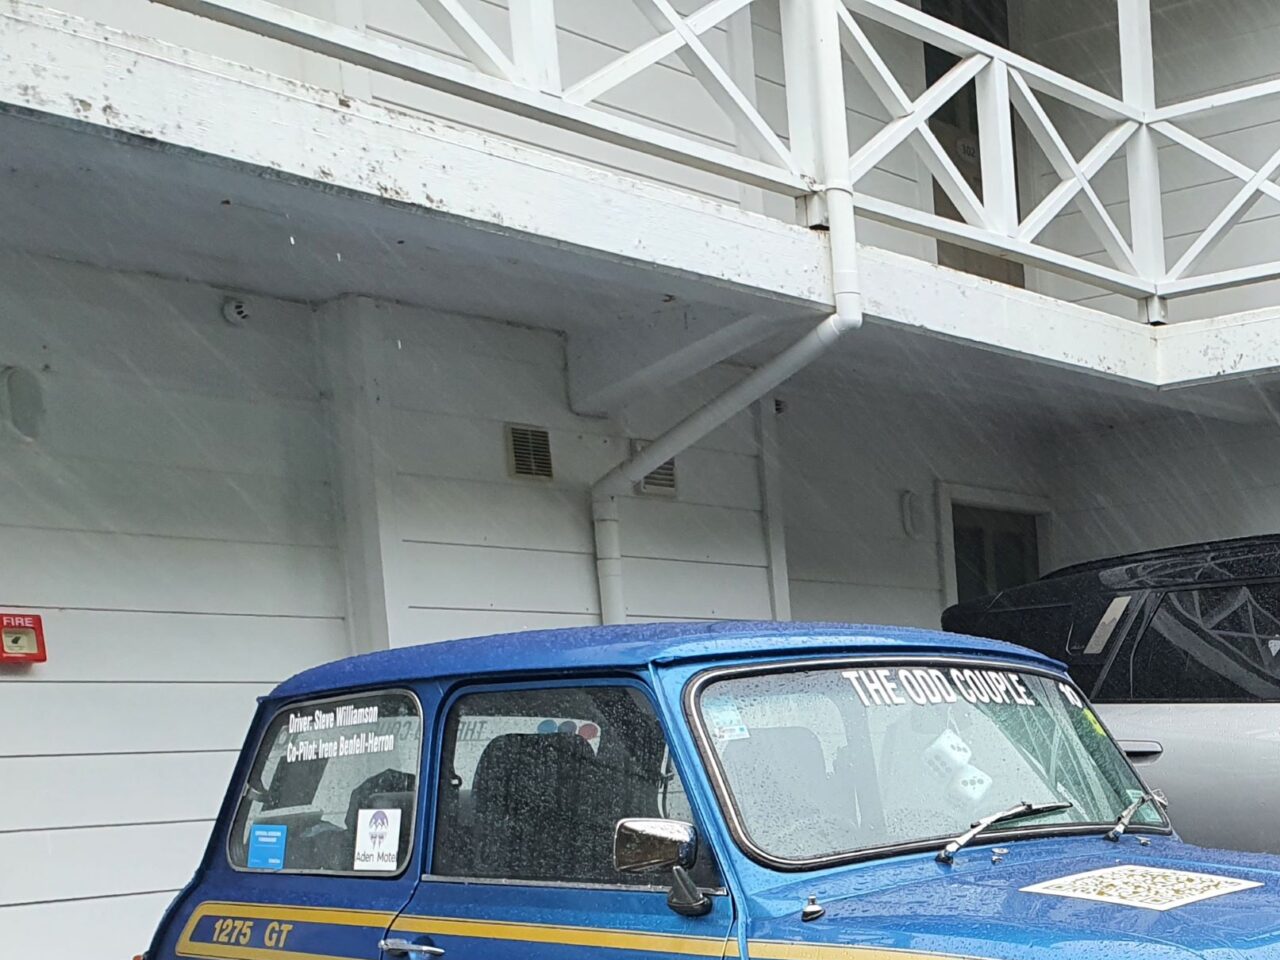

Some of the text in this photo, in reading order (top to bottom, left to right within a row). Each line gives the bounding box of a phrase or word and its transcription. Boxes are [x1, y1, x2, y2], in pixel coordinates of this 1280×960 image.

[2, 616, 34, 627] FIRE
[842, 669, 1035, 706] THE ODD COUPLE
[289, 713, 313, 734] Driver:
[336, 704, 378, 727] Williamson
[287, 740, 317, 763] Co-Pilot:
[319, 738, 338, 759] Irene
[356, 851, 374, 862] Aden
[212, 918, 293, 948] 1275 GT
